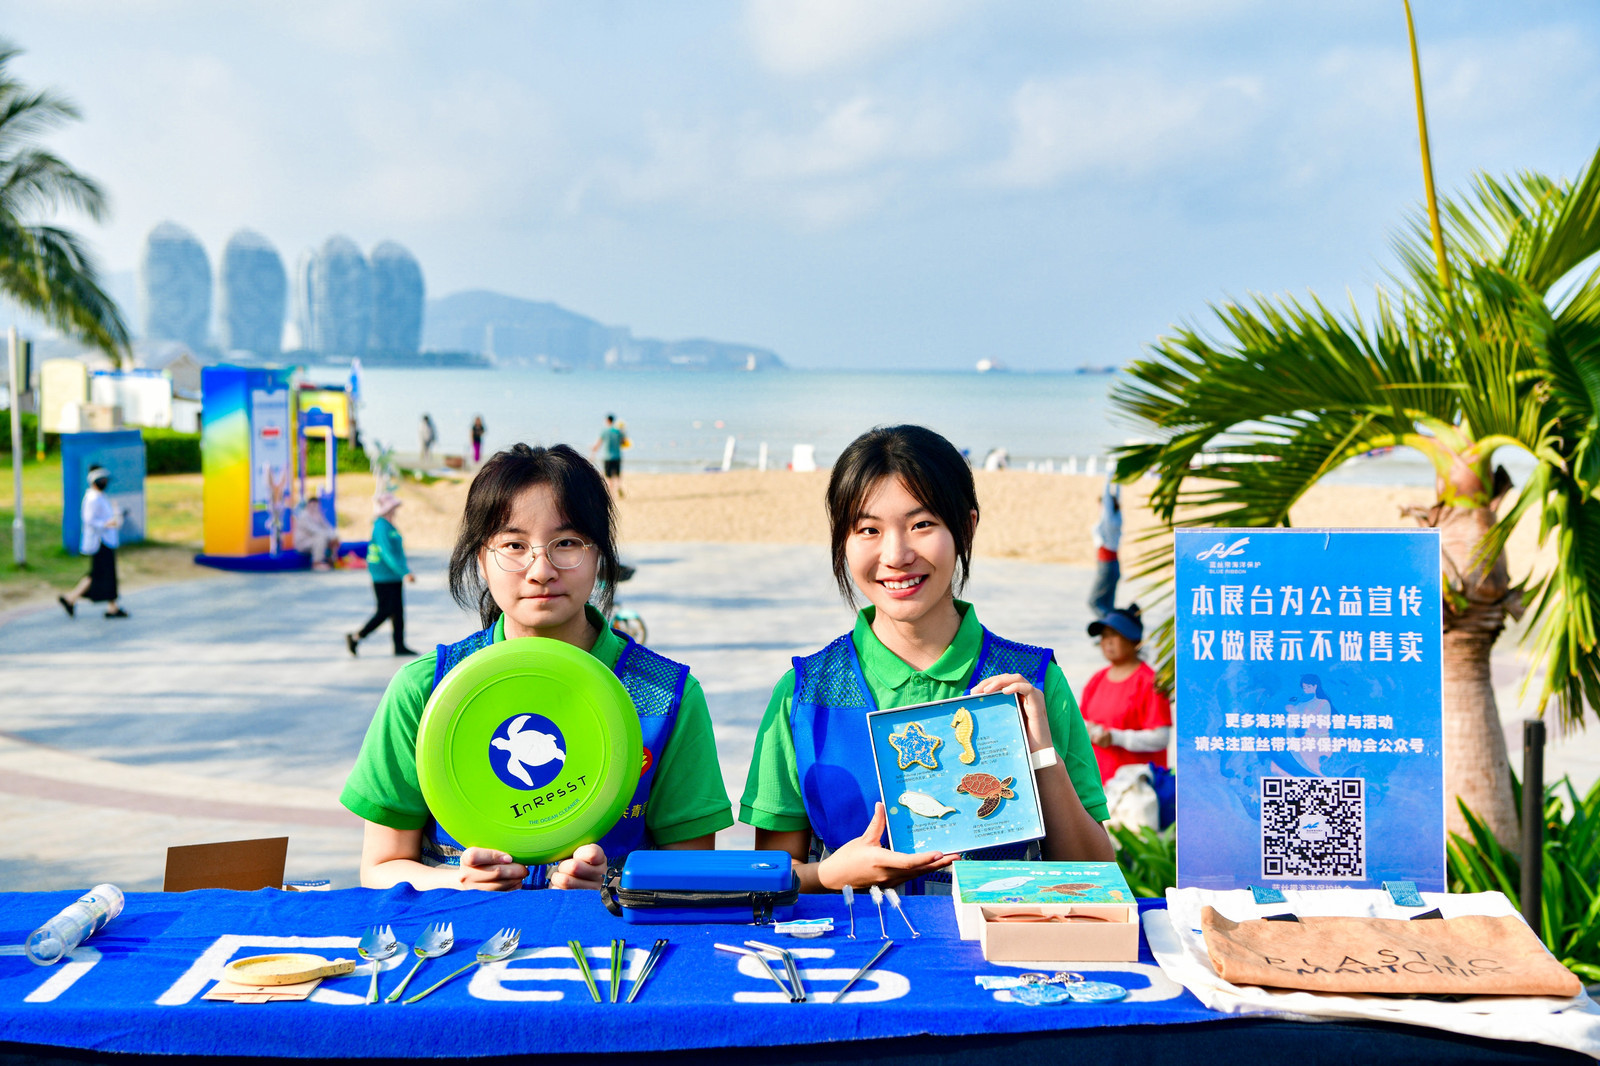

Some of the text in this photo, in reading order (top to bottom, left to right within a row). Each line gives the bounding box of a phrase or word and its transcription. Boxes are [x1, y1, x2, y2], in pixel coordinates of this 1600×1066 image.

[1191, 585, 1423, 617] 本展台为公益宣传
[1191, 629, 1423, 662] 仅做展示不做售卖
[1225, 713, 1394, 730] 更多海洋保护科普与活动
[1195, 736, 1425, 754] 请关注蓝丝带海洋保护协会公众号
[540, 814, 559, 824] OCEAN
[558, 798, 581, 817] CLEANER
[1264, 949, 1503, 970] PLASTIC
